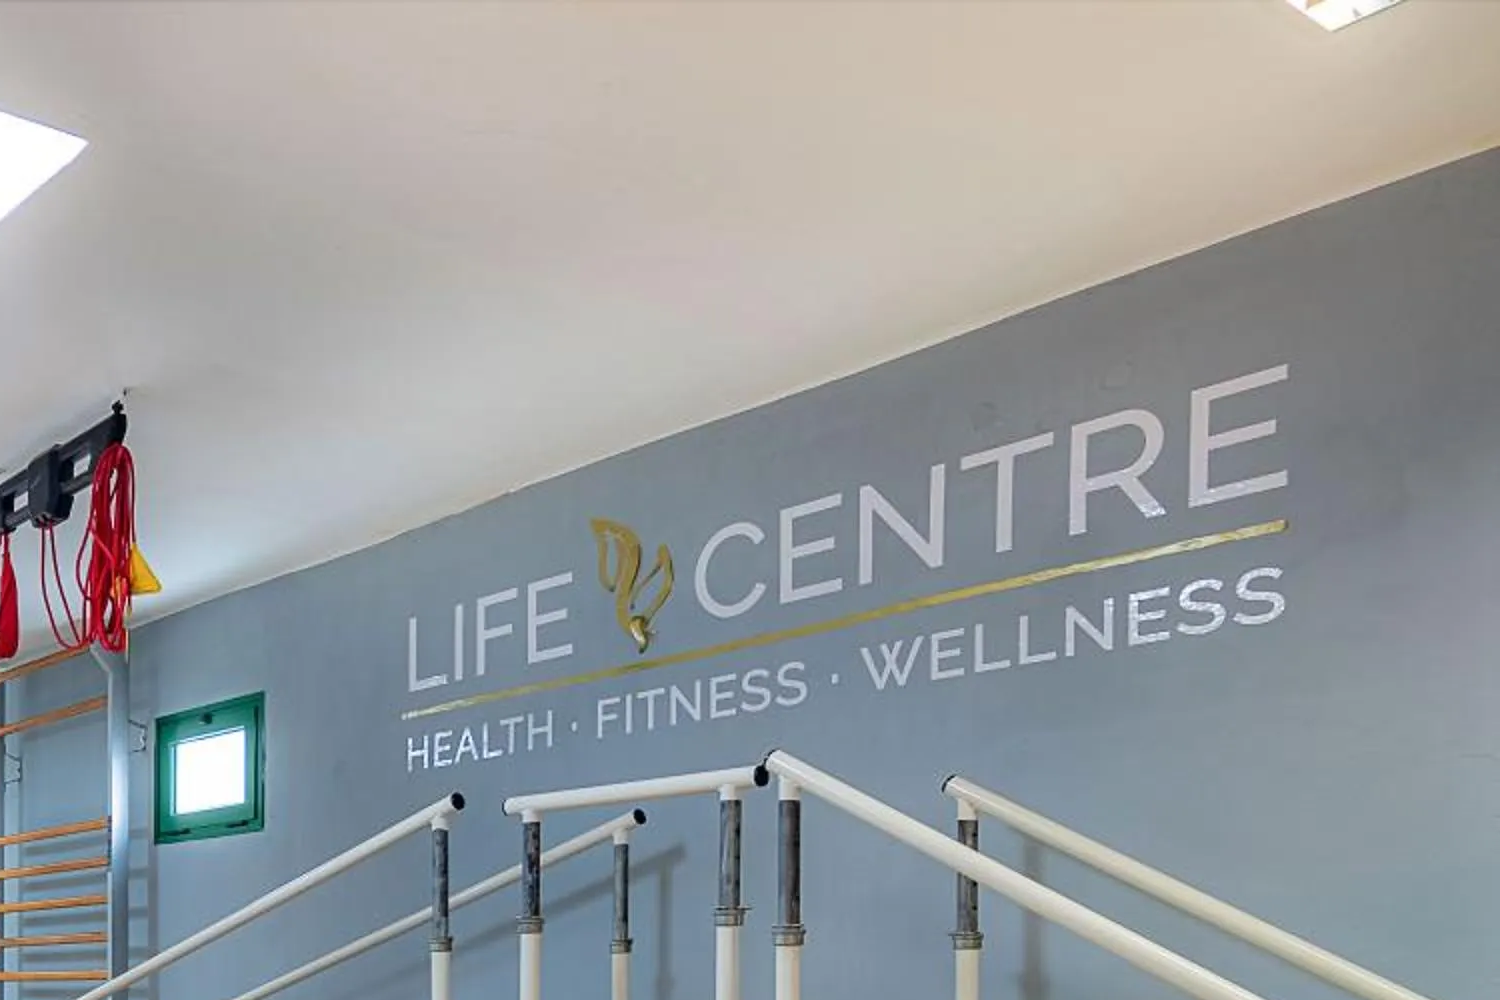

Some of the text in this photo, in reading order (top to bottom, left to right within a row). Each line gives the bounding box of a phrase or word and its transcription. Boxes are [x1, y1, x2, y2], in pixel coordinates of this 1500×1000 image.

[408, 364, 1290, 692] LIFE CENTRE
[407, 568, 1286, 772] HEALTH FITNESS WELLNESS
